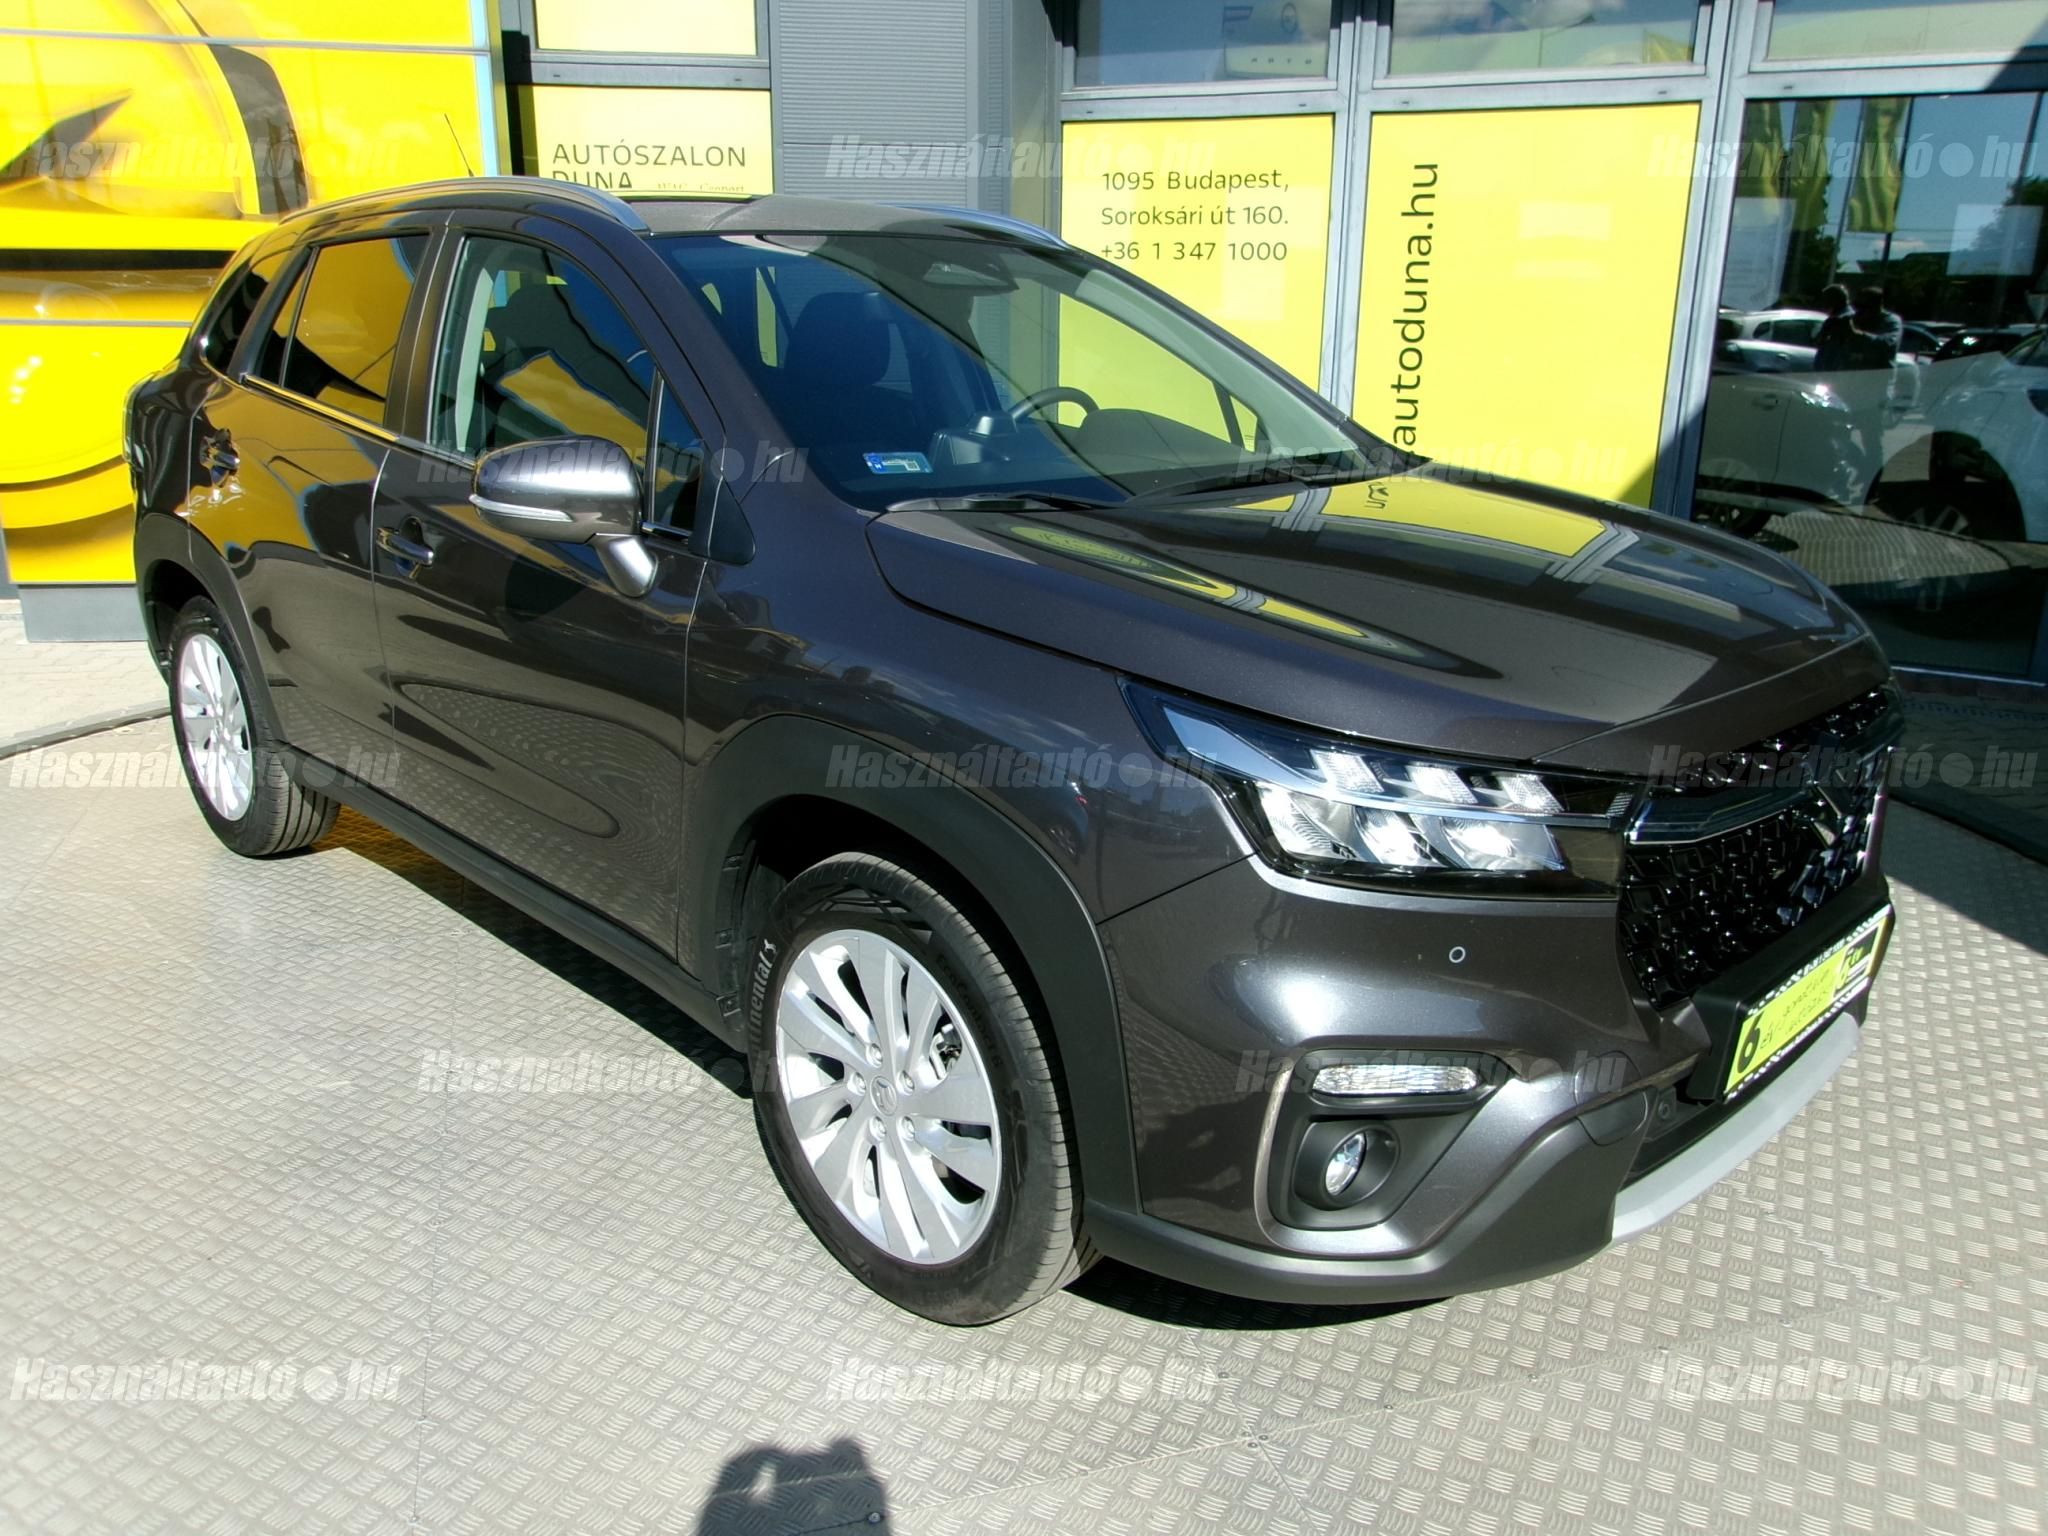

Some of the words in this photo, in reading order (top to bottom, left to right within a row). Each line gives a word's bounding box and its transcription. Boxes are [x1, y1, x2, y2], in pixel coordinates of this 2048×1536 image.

[552, 139, 746, 168] AUTÓSZALON
[1102, 172, 1155, 192] 1095
[1167, 168, 1290, 194] Budapest,
[1101, 205, 1203, 226] Soroksári
[1210, 206, 1236, 225] út
[1244, 206, 1289, 226] 160.
[1101, 242, 1141, 261] +36
[1152, 242, 1161, 261] 1
[1172, 242, 1217, 261] 347
[1229, 242, 1288, 261] 1000
[1391, 163, 1439, 447] autoduna.hu
[1737, 1010, 1765, 1074] 6
